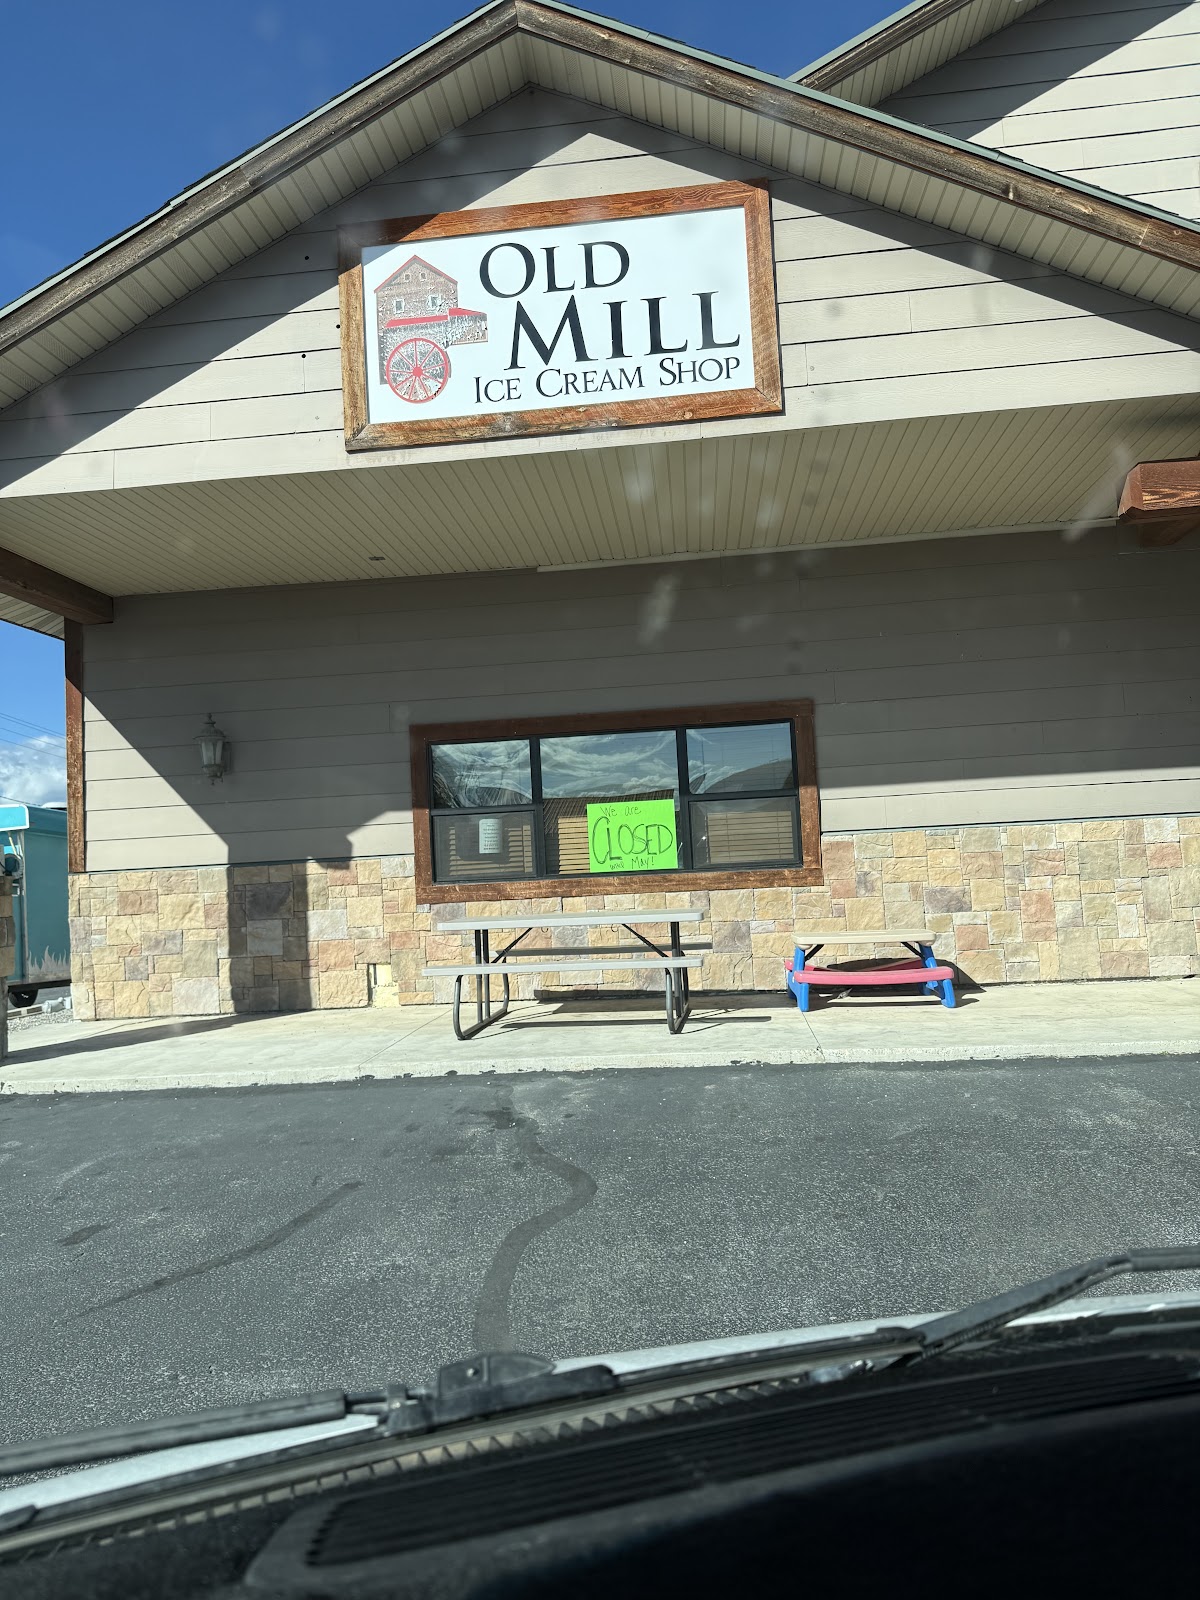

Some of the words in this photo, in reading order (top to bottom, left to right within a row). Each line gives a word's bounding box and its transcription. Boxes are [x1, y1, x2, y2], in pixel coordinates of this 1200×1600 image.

[479, 240, 630, 298] OLD
[503, 290, 741, 371] MILL
[474, 375, 522, 404] ICE
[535, 365, 646, 399] CREAM
[658, 356, 741, 387] SHOP
[600, 805, 617, 817] We
[624, 805, 642, 816] are
[592, 816, 674, 865] CLOSED
[631, 855, 655, 869] May!
